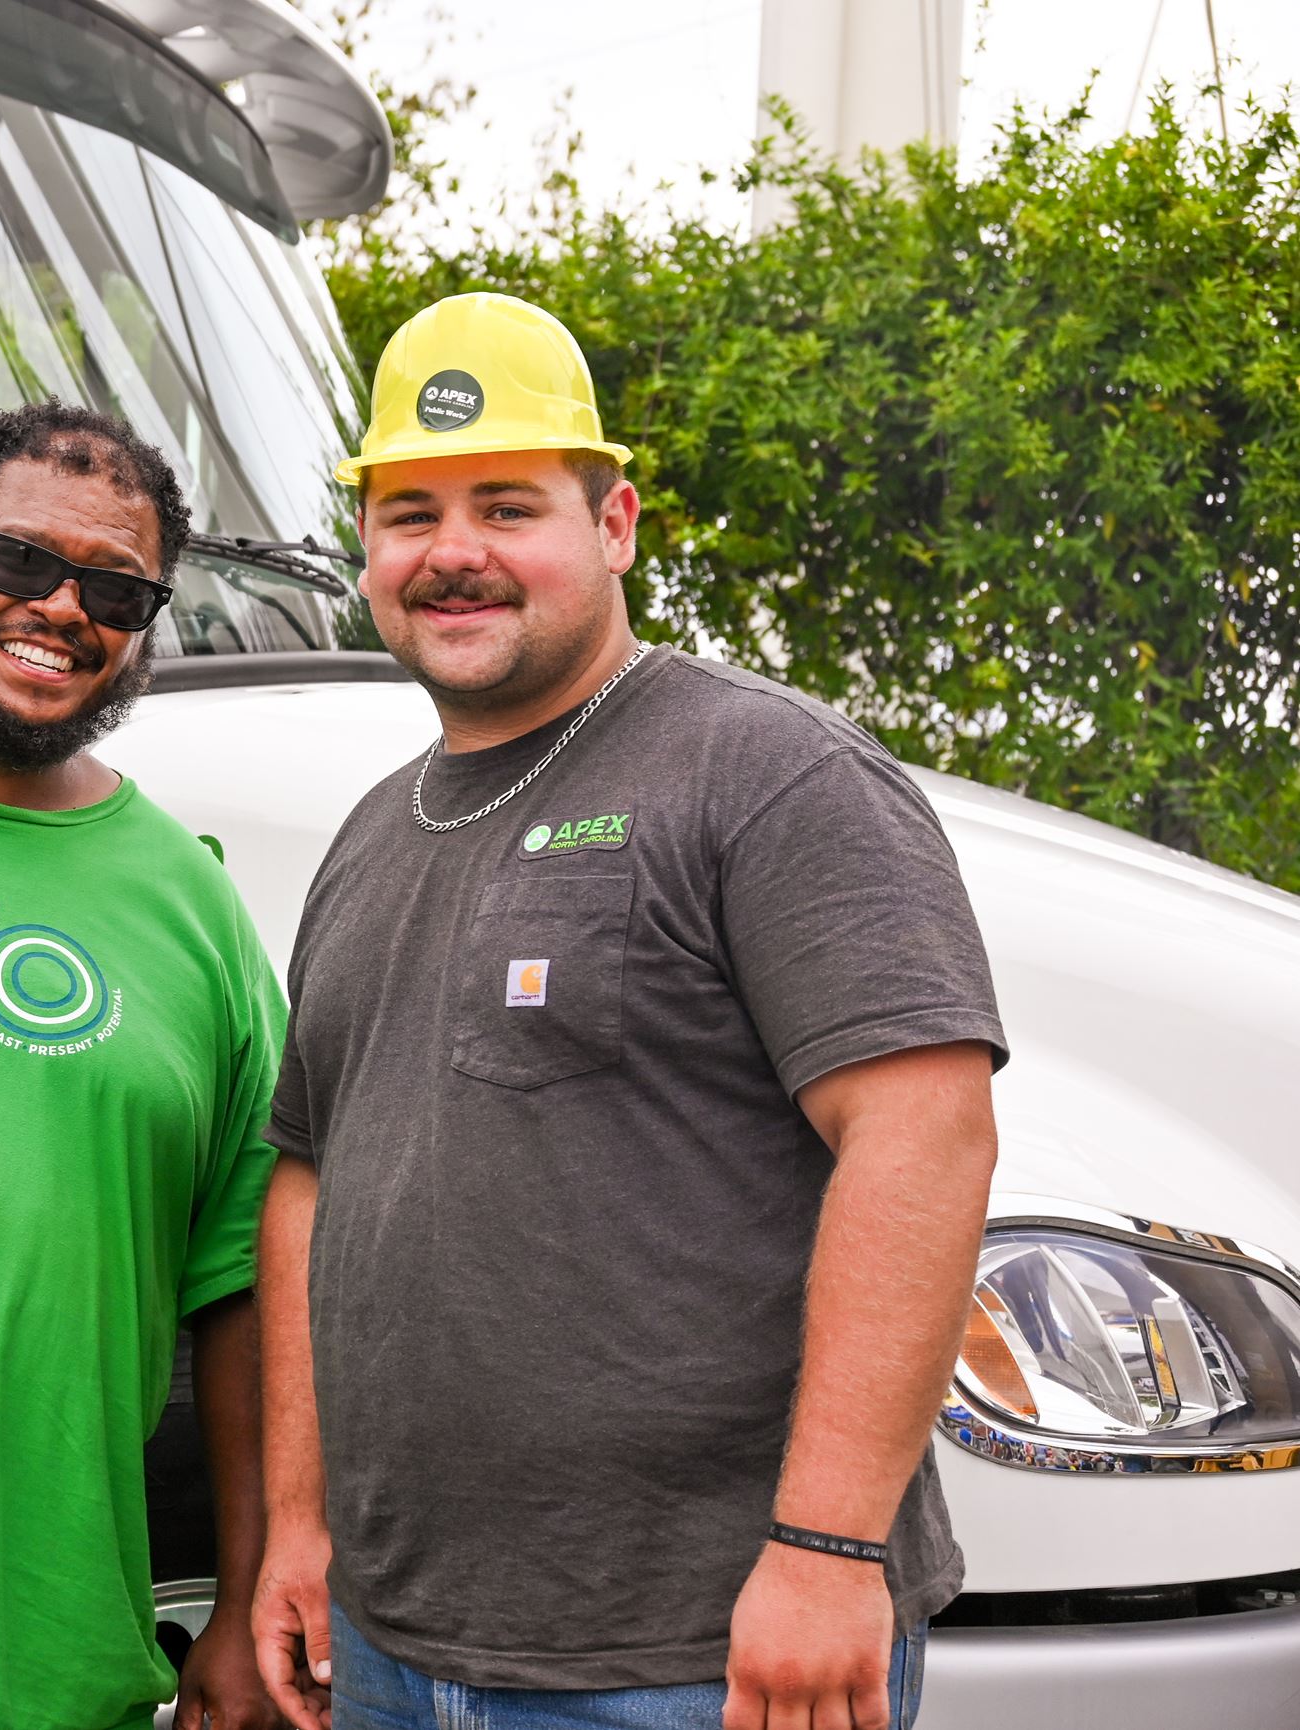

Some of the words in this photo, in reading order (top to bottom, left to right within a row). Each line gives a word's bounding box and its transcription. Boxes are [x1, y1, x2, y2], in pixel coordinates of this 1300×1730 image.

[439, 389, 477, 405] APEX
[425, 406, 445, 414] Public
[446, 410, 467, 419] Works
[552, 814, 630, 841] APEX
[548, 841, 577, 850] NORTH
[579, 834, 623, 846] CAROLINA
[28, 1038, 94, 1056] PRESENT
[95, 987, 124, 1043] POTENTIAL
